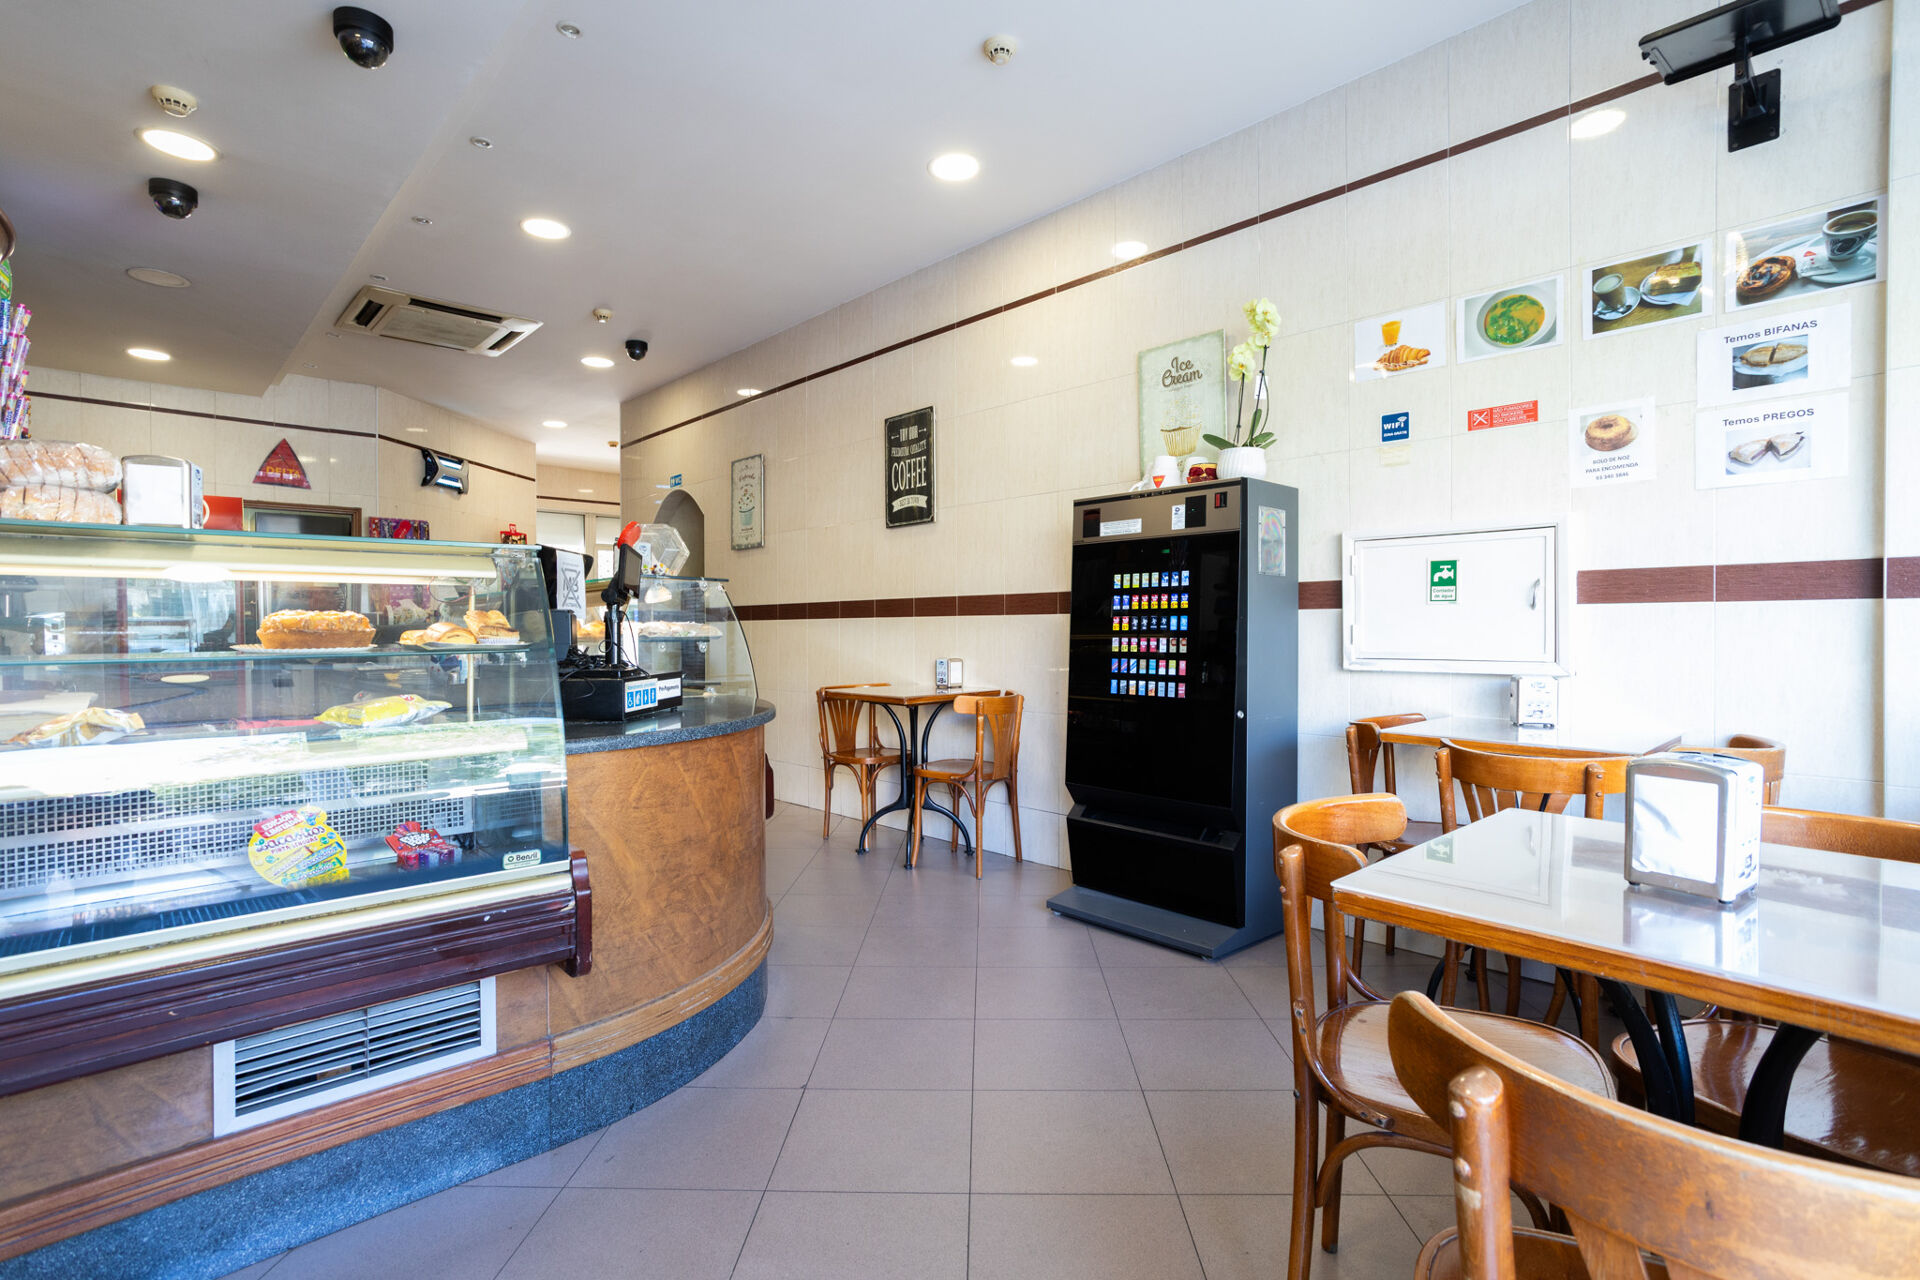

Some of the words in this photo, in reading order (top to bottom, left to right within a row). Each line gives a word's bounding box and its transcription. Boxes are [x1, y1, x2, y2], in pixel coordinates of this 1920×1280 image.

[1723, 332, 1761, 344] Temos
[1764, 320, 1818, 337] BIFANAS
[1171, 356, 1194, 373] Ice
[1161, 368, 1203, 388] Cream
[1722, 416, 1760, 427] Temos
[1763, 408, 1815, 422] PREGOS
[891, 456, 927, 492] COFFEE
[1601, 461, 1639, 472] ENCOMENDA
